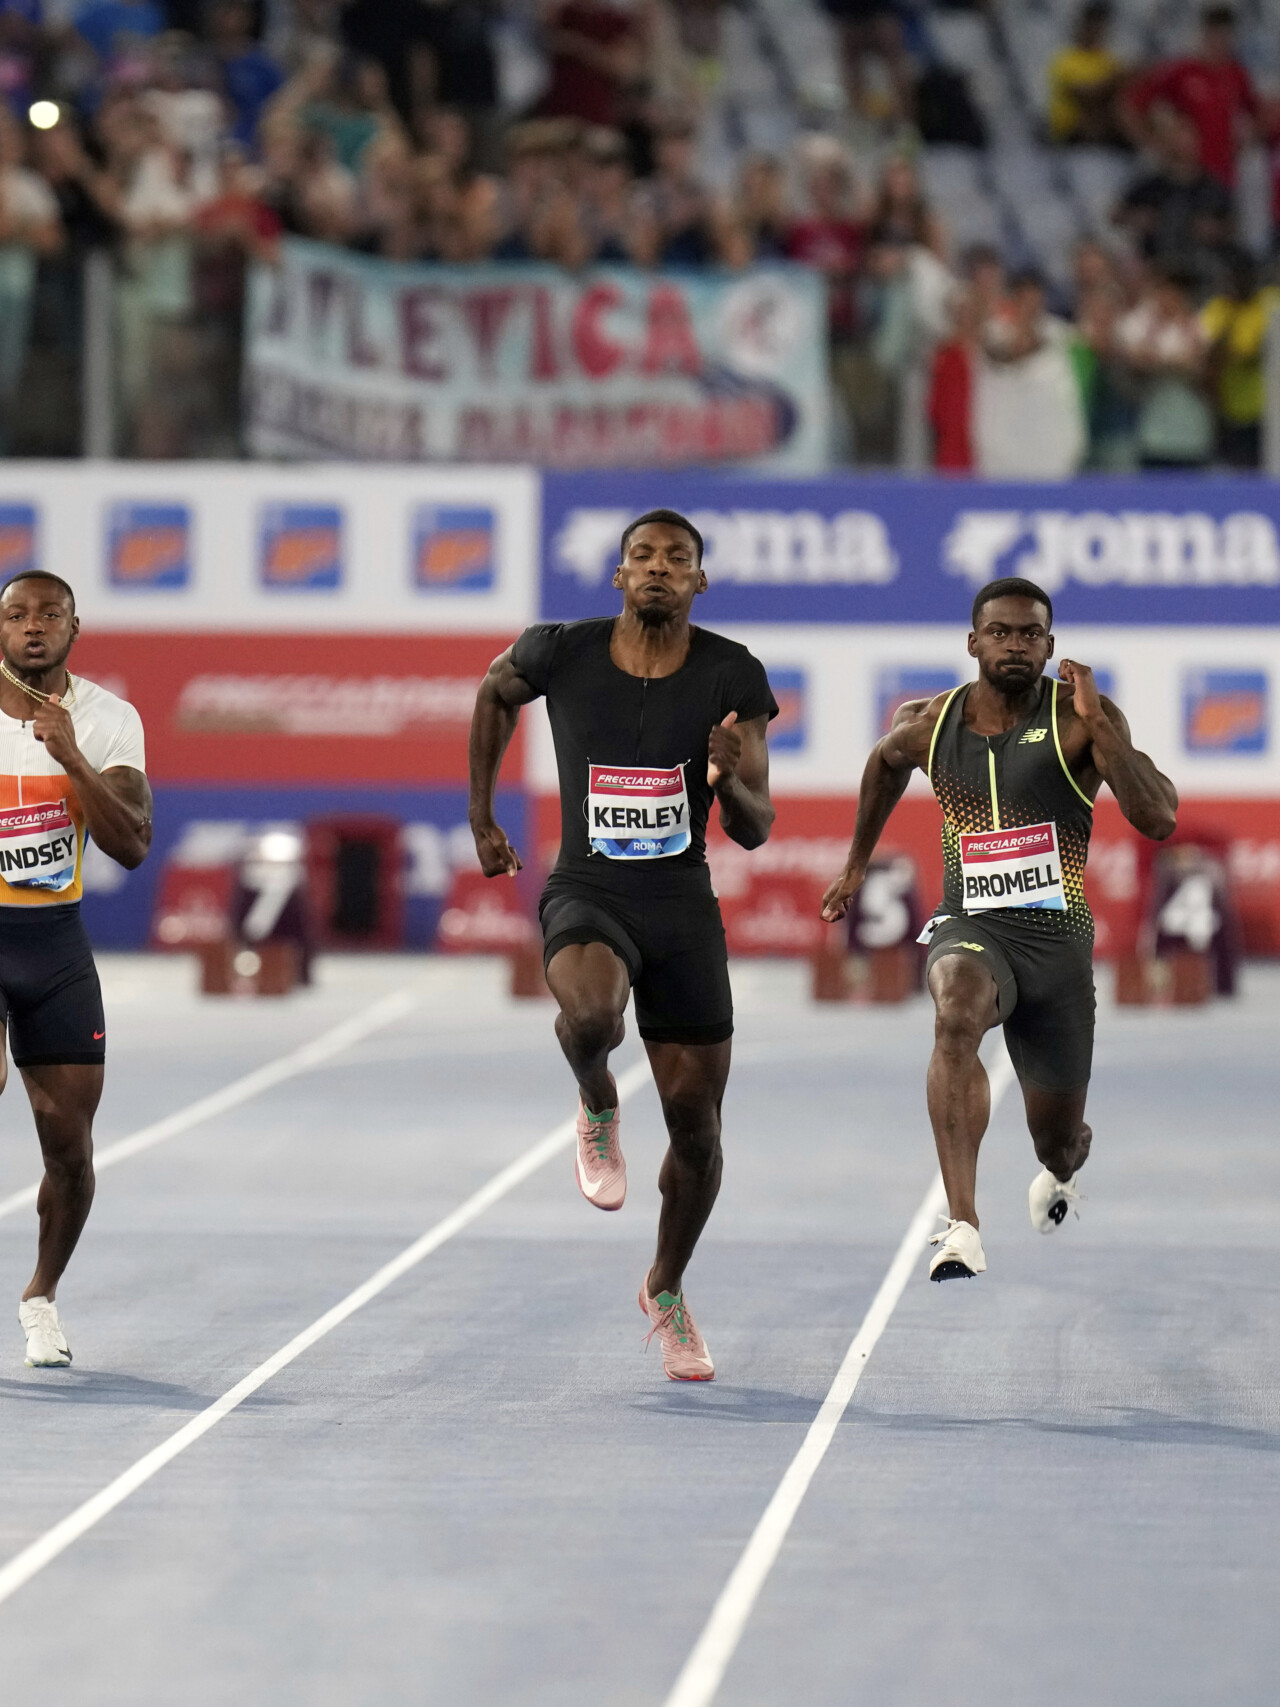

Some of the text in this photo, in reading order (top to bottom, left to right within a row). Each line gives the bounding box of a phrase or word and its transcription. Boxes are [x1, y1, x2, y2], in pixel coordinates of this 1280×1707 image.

[597, 774, 680, 786] FRECCIAROSSA
[593, 802, 685, 829] KERLEY
[633, 841, 663, 851] ROMA
[967, 832, 1049, 852] FRECCIAROSSA
[965, 864, 1060, 899] BROMELL
[240, 858, 304, 943] 7
[856, 864, 916, 948] 5
[1158, 872, 1220, 951] 4
